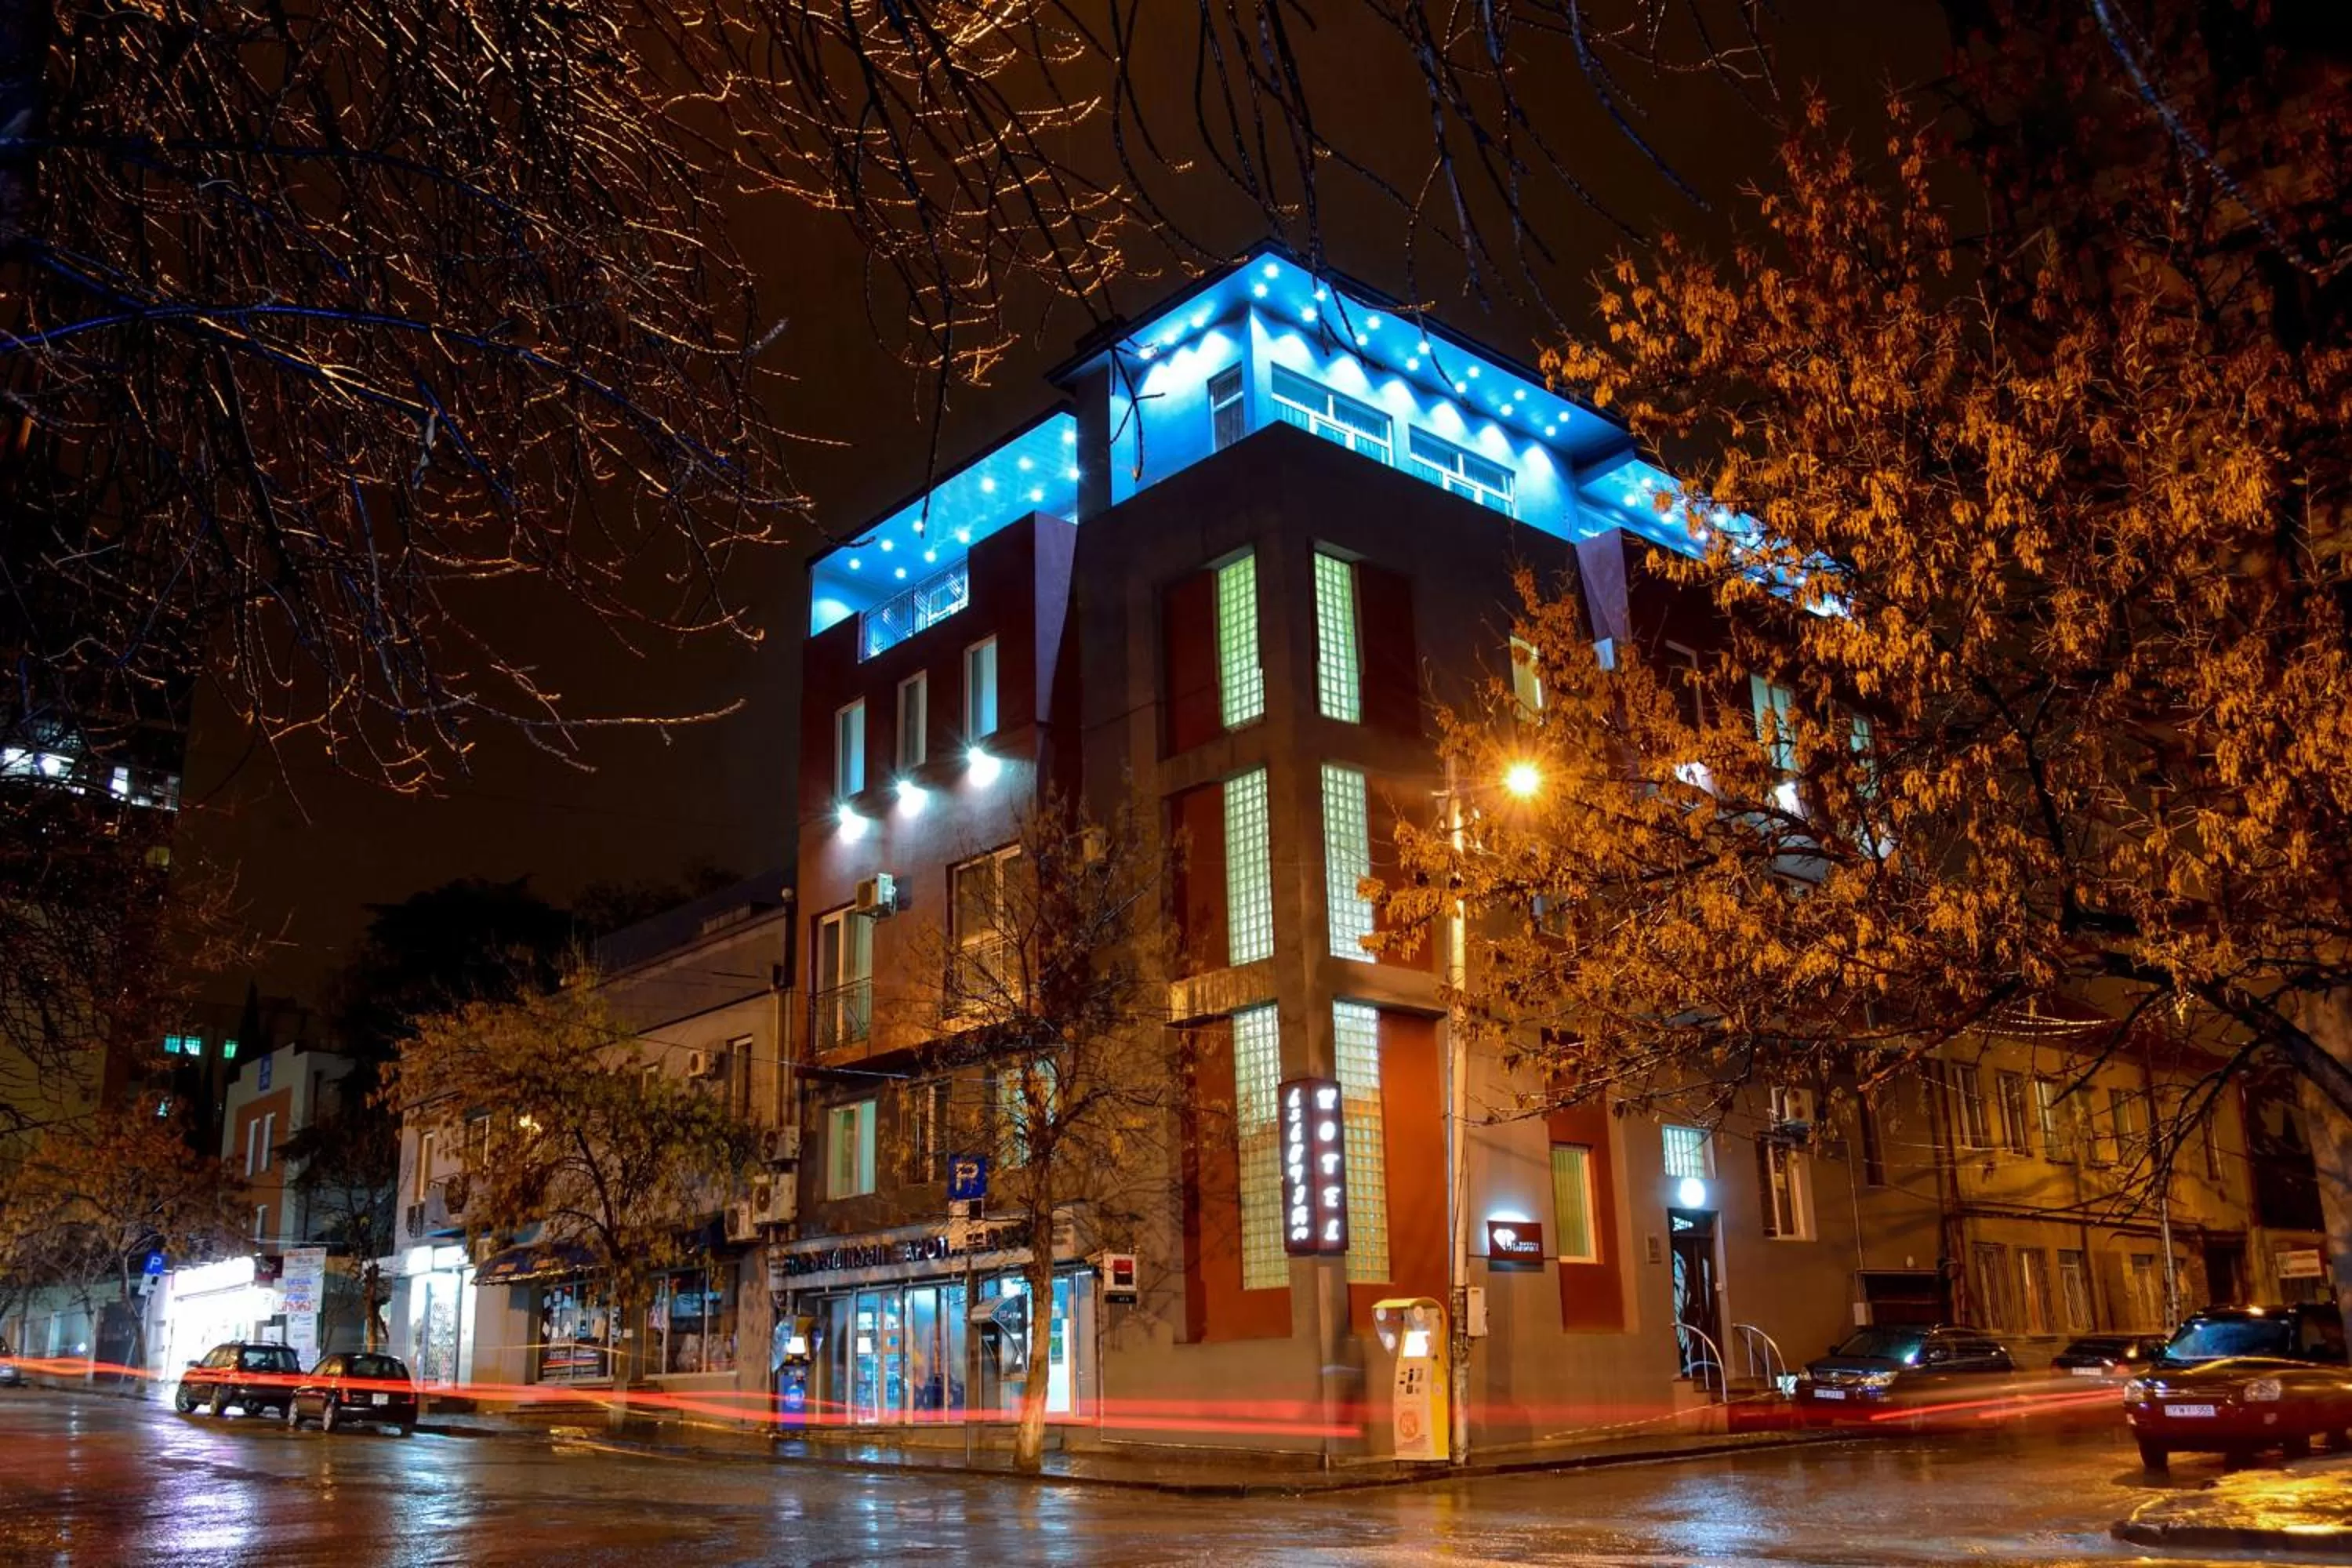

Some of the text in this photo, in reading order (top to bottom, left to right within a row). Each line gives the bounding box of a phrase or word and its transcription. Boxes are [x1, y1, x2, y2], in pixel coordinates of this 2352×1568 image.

[955, 1163, 978, 1191] P
[1316, 1088, 1341, 1241] HOTEL
[149, 1257, 162, 1269] P
